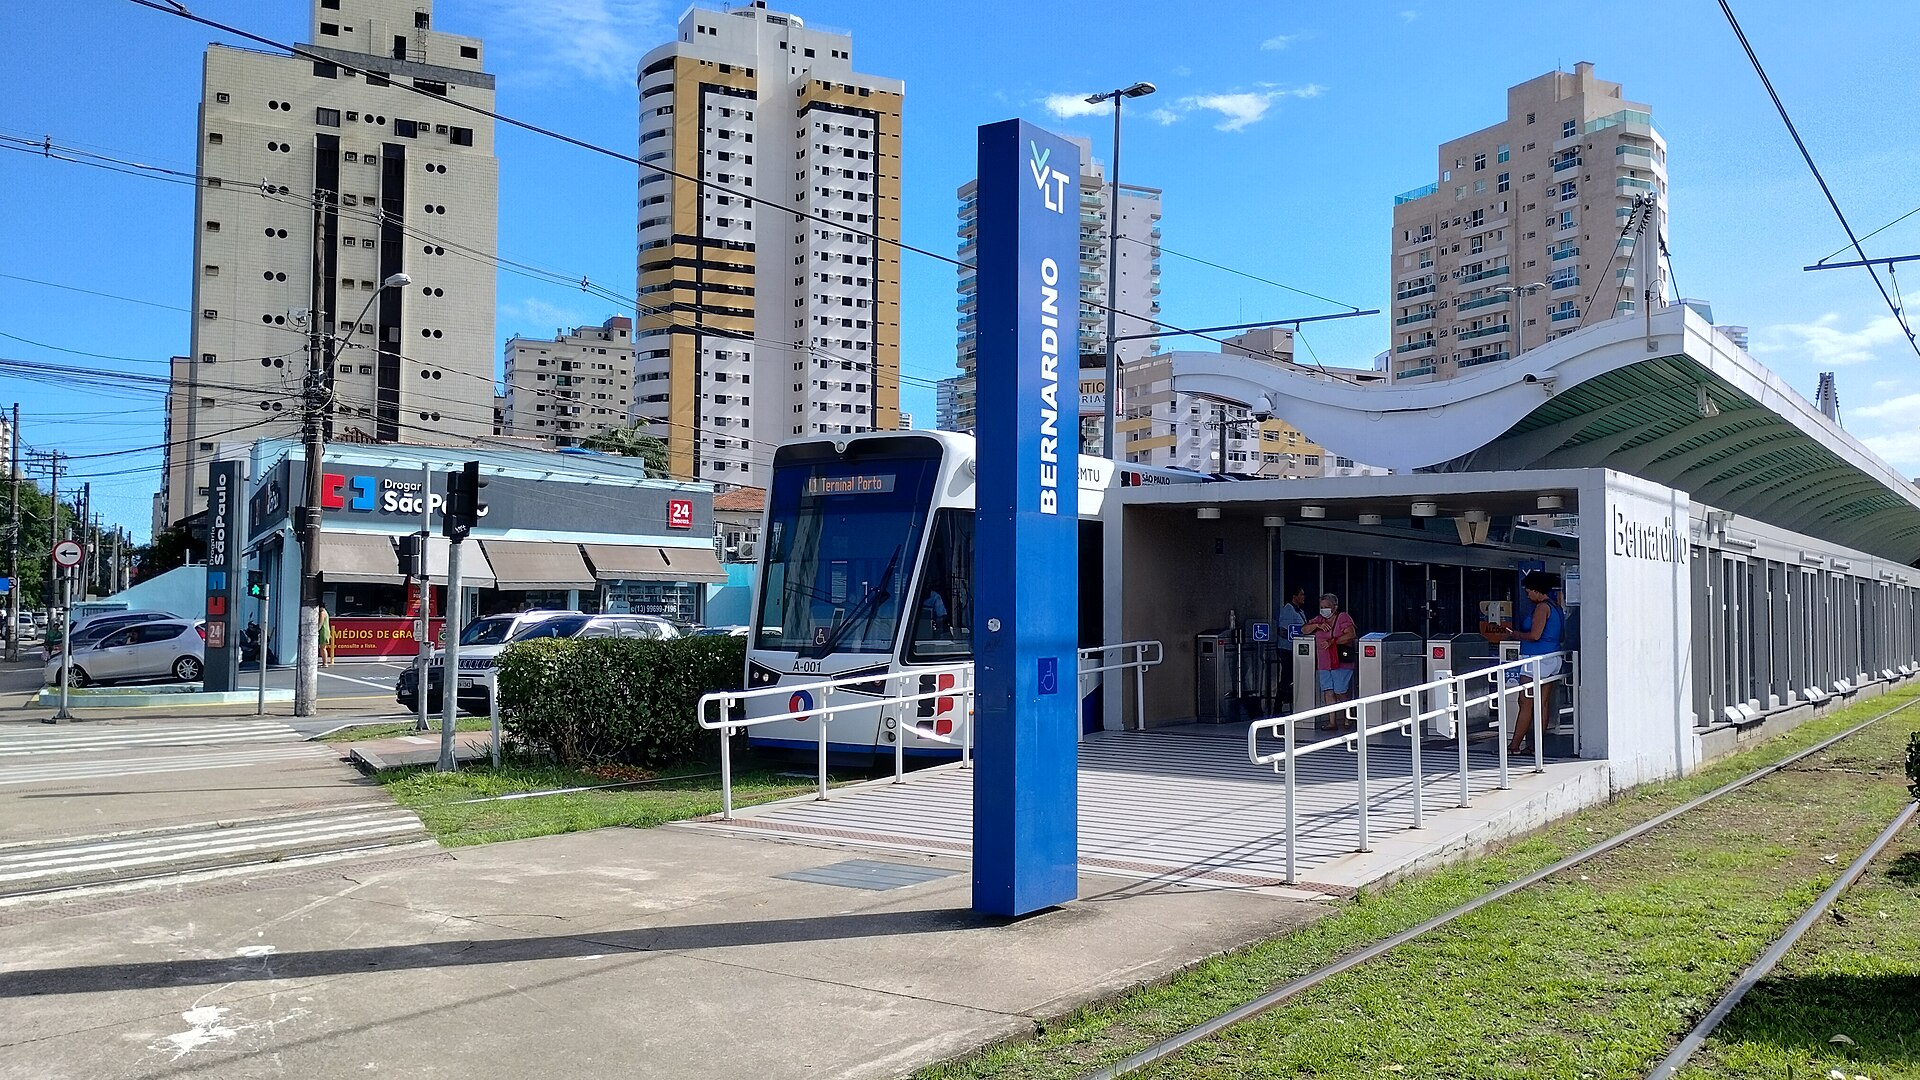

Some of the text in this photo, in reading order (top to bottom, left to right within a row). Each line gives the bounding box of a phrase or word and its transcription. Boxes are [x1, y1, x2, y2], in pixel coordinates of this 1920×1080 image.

[1030, 140, 1069, 214] VLT
[1040, 258, 1059, 515] BERNARDINO
[1078, 468, 1100, 482] MTU
[384, 479, 422, 491] Drogar
[822, 476, 854, 492] Terminal
[857, 475, 882, 490] Porto
[673, 504, 689, 517] 24
[1613, 504, 1687, 564] Bernardino
[210, 625, 221, 638] 24
[332, 628, 373, 639] MÉDIOS
[377, 631, 391, 639] DE
[393, 631, 415, 639] GRA
[792, 661, 821, 673] A-001
